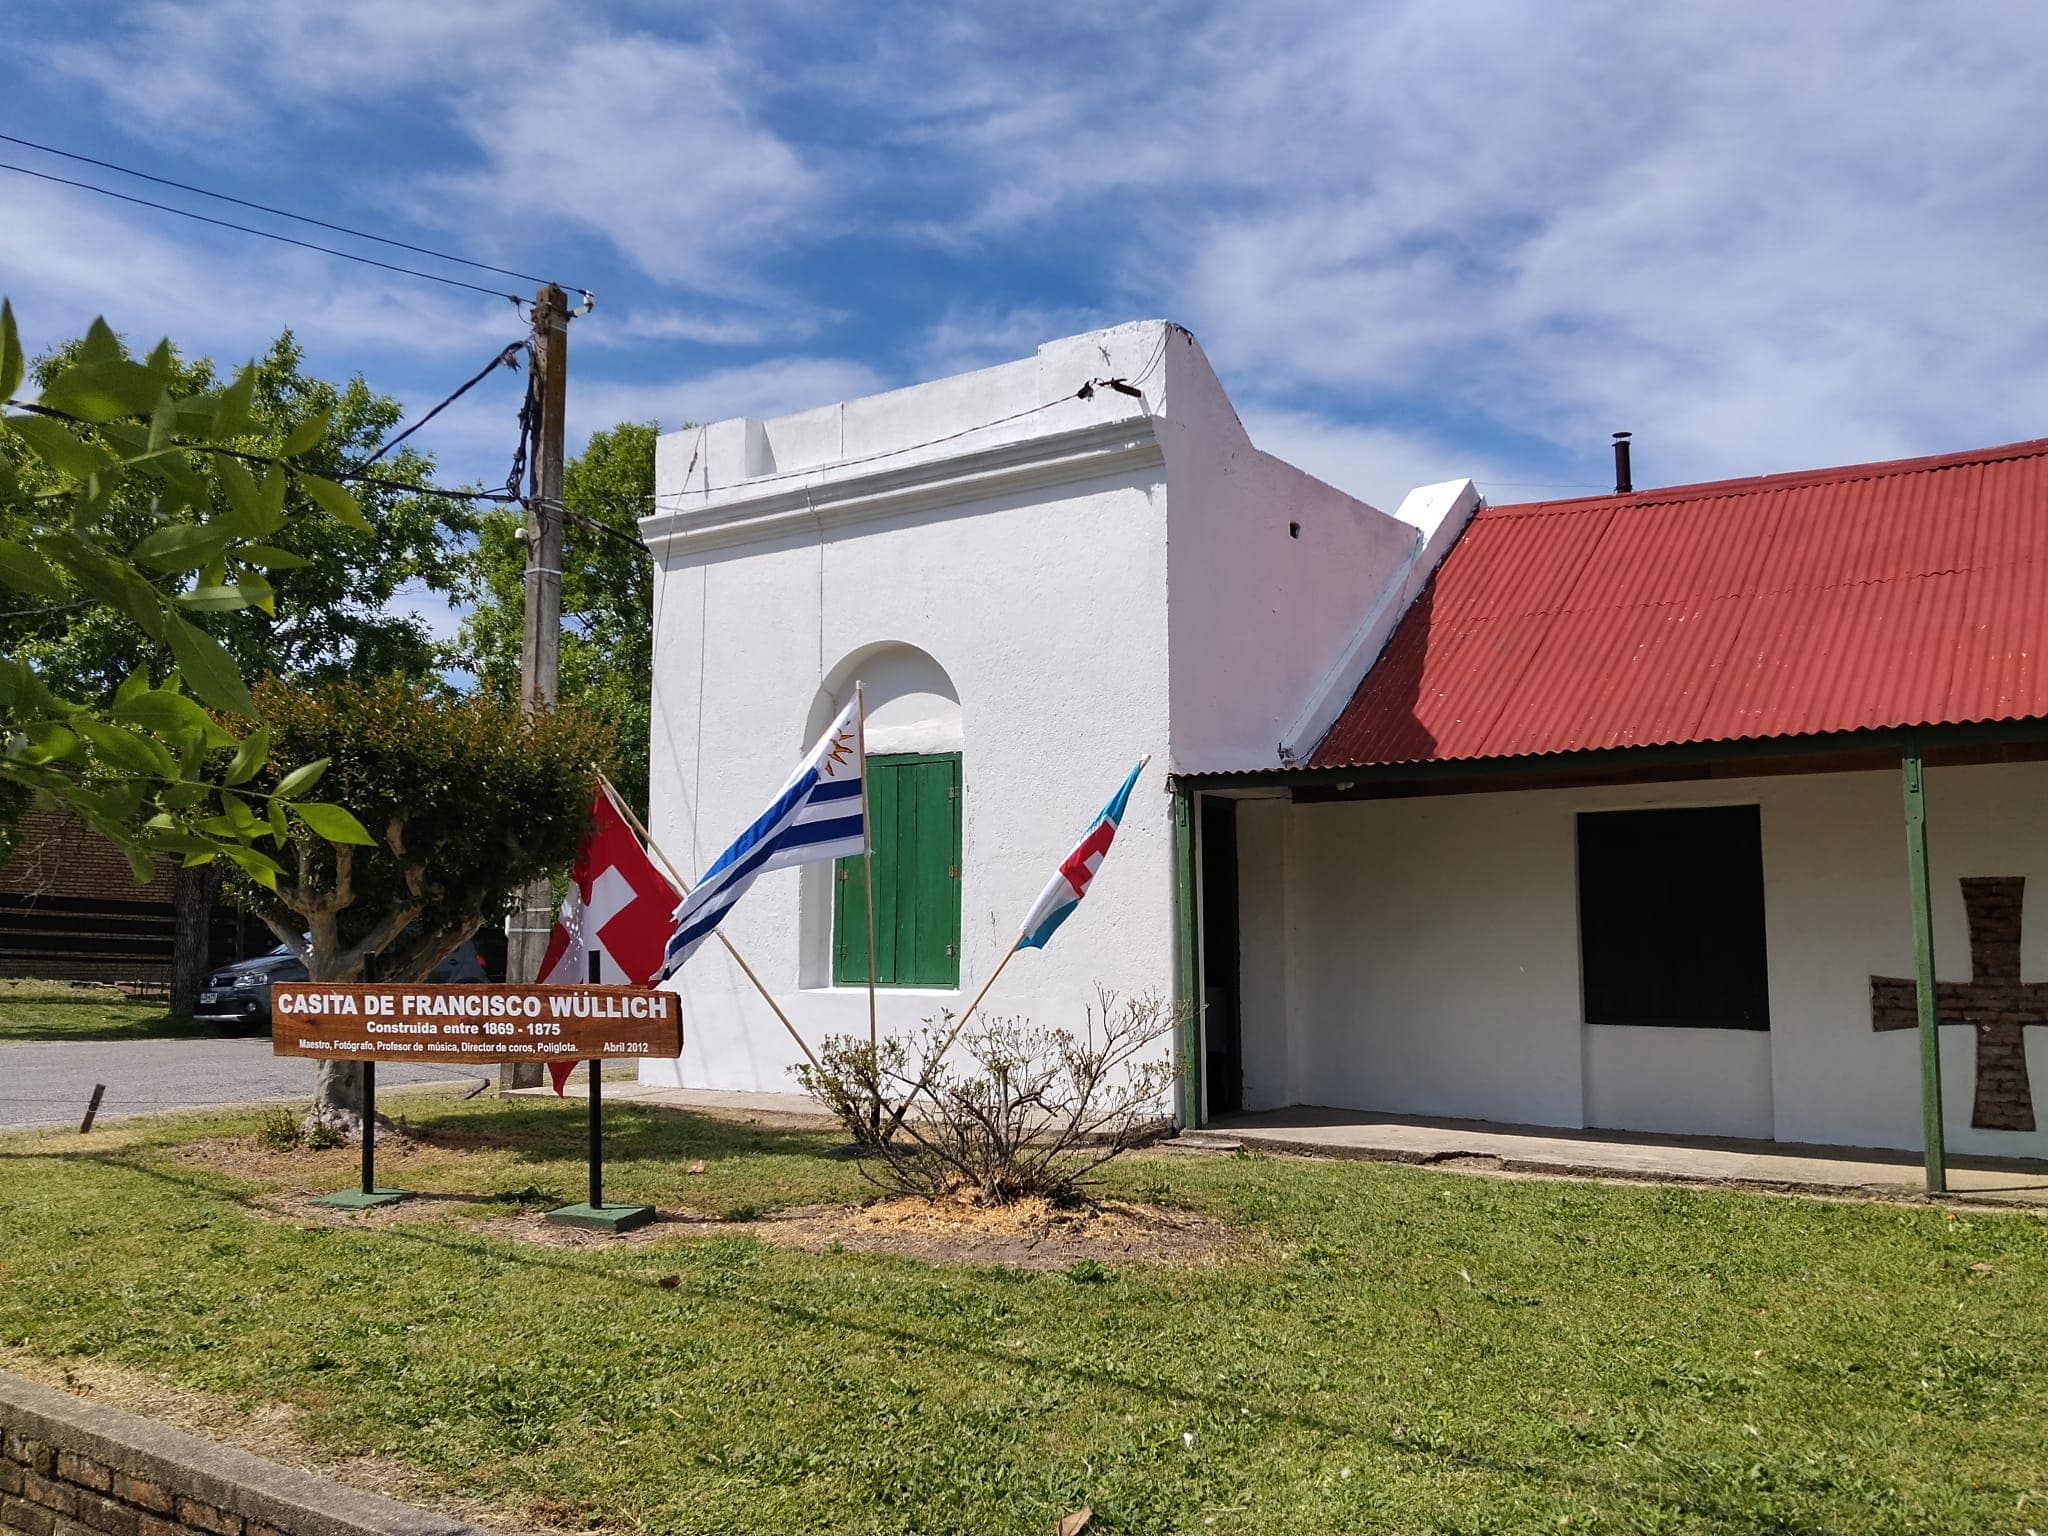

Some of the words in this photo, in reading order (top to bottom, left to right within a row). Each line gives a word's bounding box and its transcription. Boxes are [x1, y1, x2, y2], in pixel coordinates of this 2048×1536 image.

[278, 994, 358, 1015] CASITA
[365, 995, 395, 1016] DE
[403, 995, 542, 1017] FRANCISCO
[549, 992, 667, 1019] WÜLLICH
[367, 1021, 438, 1034] Construida
[443, 1022, 479, 1035] entre
[482, 1022, 515, 1035] 1869
[526, 1023, 561, 1036] 1875
[299, 1039, 333, 1051] Maestro,
[334, 1040, 376, 1053] Fotógrafo,
[377, 1041, 411, 1052] Profesor
[413, 1042, 424, 1052] de
[428, 1042, 460, 1053] música,
[462, 1042, 495, 1053] Director
[496, 1043, 507, 1053] de
[508, 1043, 536, 1054] coros,
[604, 1042, 625, 1053] Abril
[626, 1042, 649, 1053] 2012
